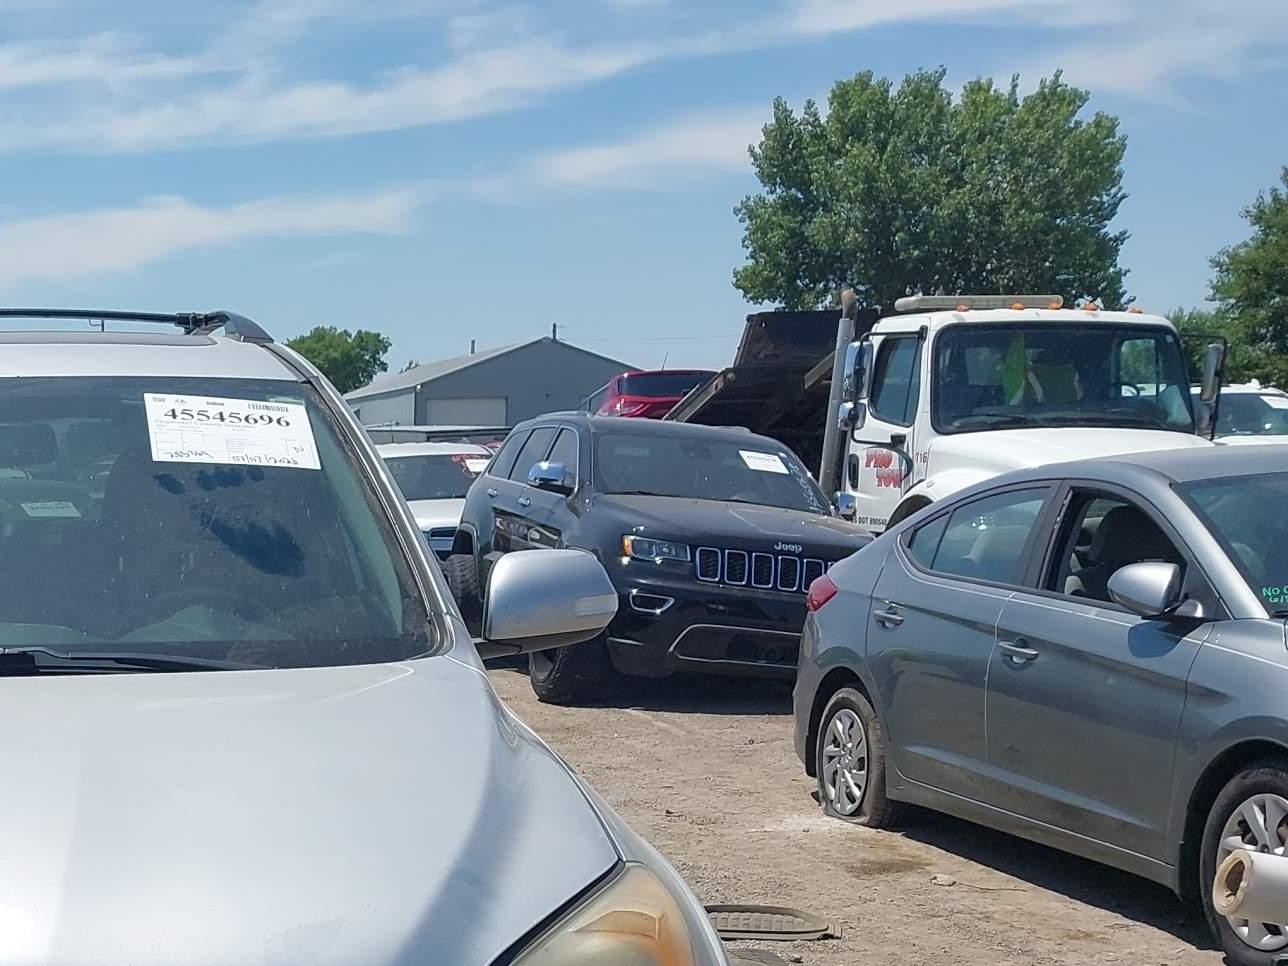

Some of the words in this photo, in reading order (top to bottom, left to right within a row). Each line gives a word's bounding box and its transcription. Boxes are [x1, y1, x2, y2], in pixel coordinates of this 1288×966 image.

[164, 408, 291, 428] 45545696
[865, 449, 893, 468] PRO
[915, 451, 928, 464] 116
[876, 468, 903, 488] TOW
[858, 516, 869, 525] DOT
[774, 542, 802, 553] Jeep
